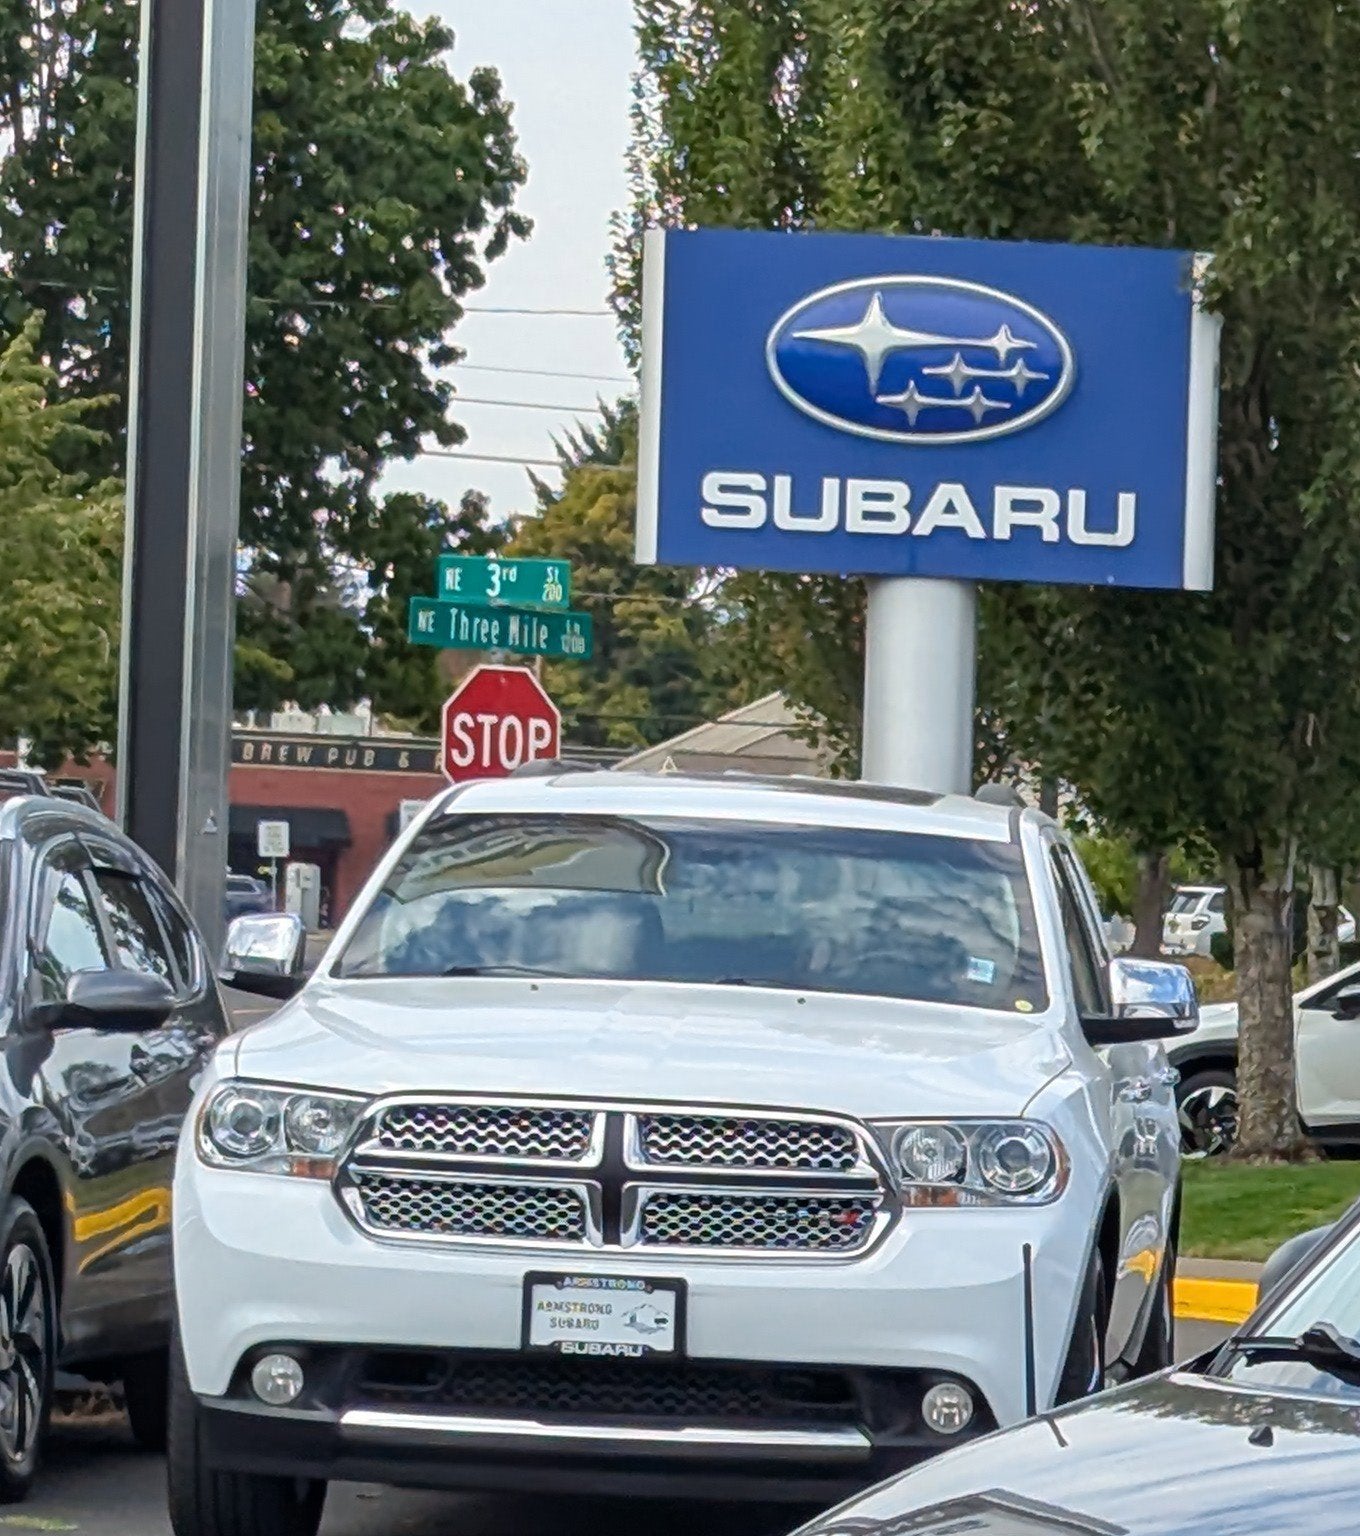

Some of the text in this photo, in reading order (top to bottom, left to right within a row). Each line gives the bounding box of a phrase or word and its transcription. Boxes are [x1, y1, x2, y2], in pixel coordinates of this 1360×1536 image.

[701, 471, 1137, 548] SUBARU
[444, 566, 463, 591] NE
[485, 563, 518, 597] 3rd
[418, 610, 436, 633] NE
[450, 607, 501, 644] Three
[508, 614, 549, 650] Mile
[242, 742, 314, 762] BREW
[327, 748, 376, 767] PUB
[450, 712, 552, 770] STOP
[561, 1343, 642, 1356] SUBARU
